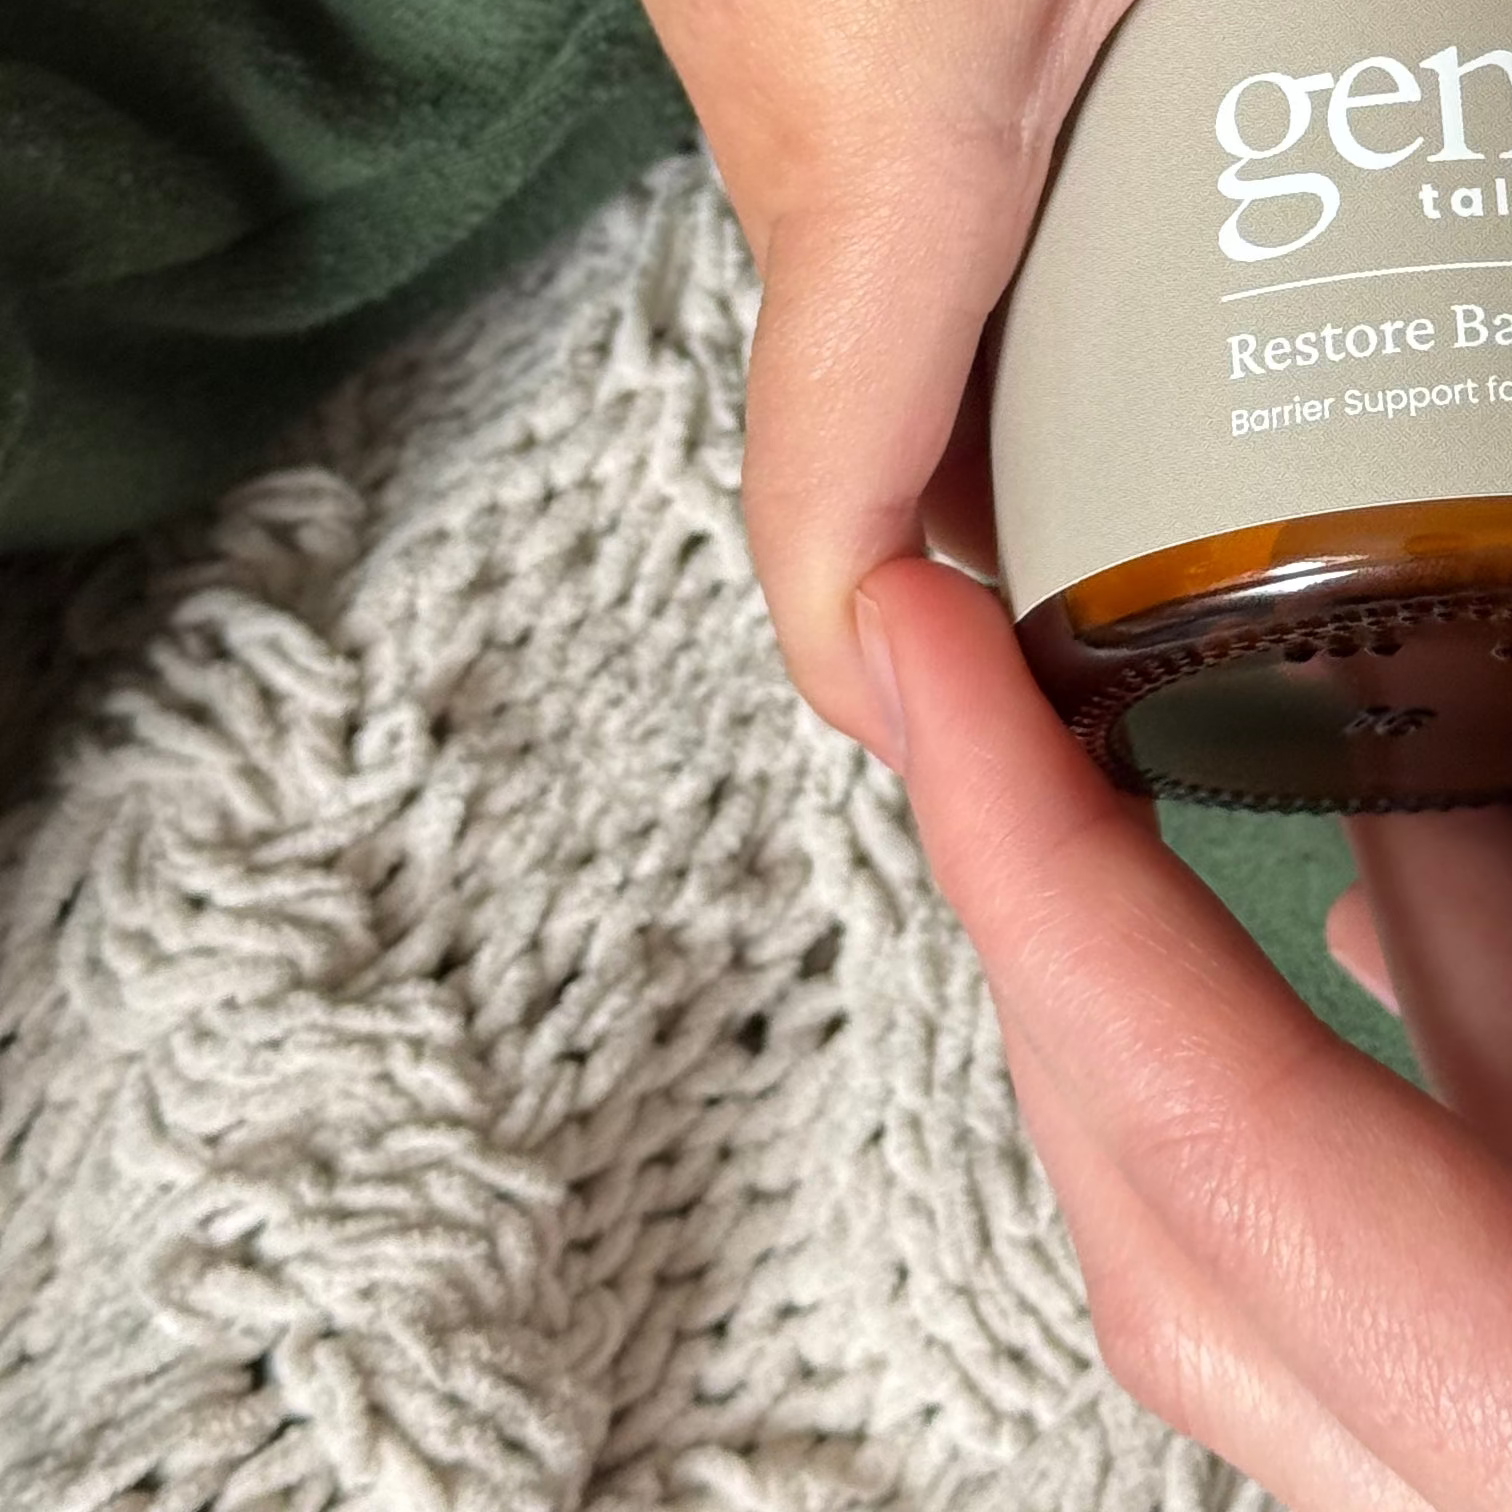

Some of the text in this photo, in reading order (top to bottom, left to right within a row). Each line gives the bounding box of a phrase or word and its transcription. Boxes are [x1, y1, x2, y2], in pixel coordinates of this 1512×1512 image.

[1227, 316, 1437, 380] Restore
[1231, 395, 1336, 437] Barrier
[1343, 374, 1481, 419] Support
